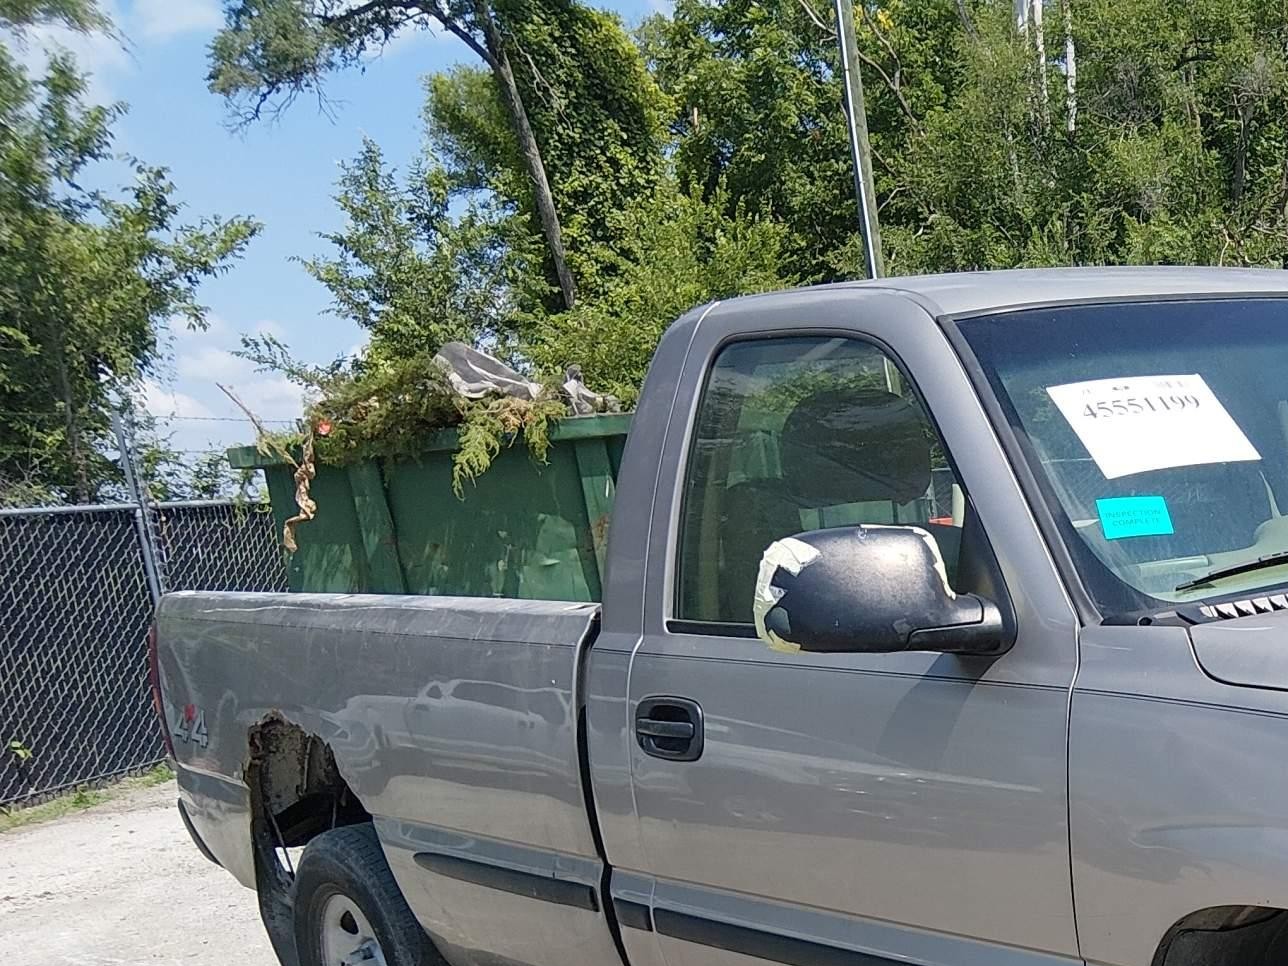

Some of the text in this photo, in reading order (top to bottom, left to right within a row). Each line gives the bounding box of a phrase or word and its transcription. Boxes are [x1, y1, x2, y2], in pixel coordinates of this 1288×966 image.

[1083, 395, 1200, 418] 45551199
[1105, 509, 1161, 518] INSPECTION
[1112, 517, 1161, 527] COMPLETE
